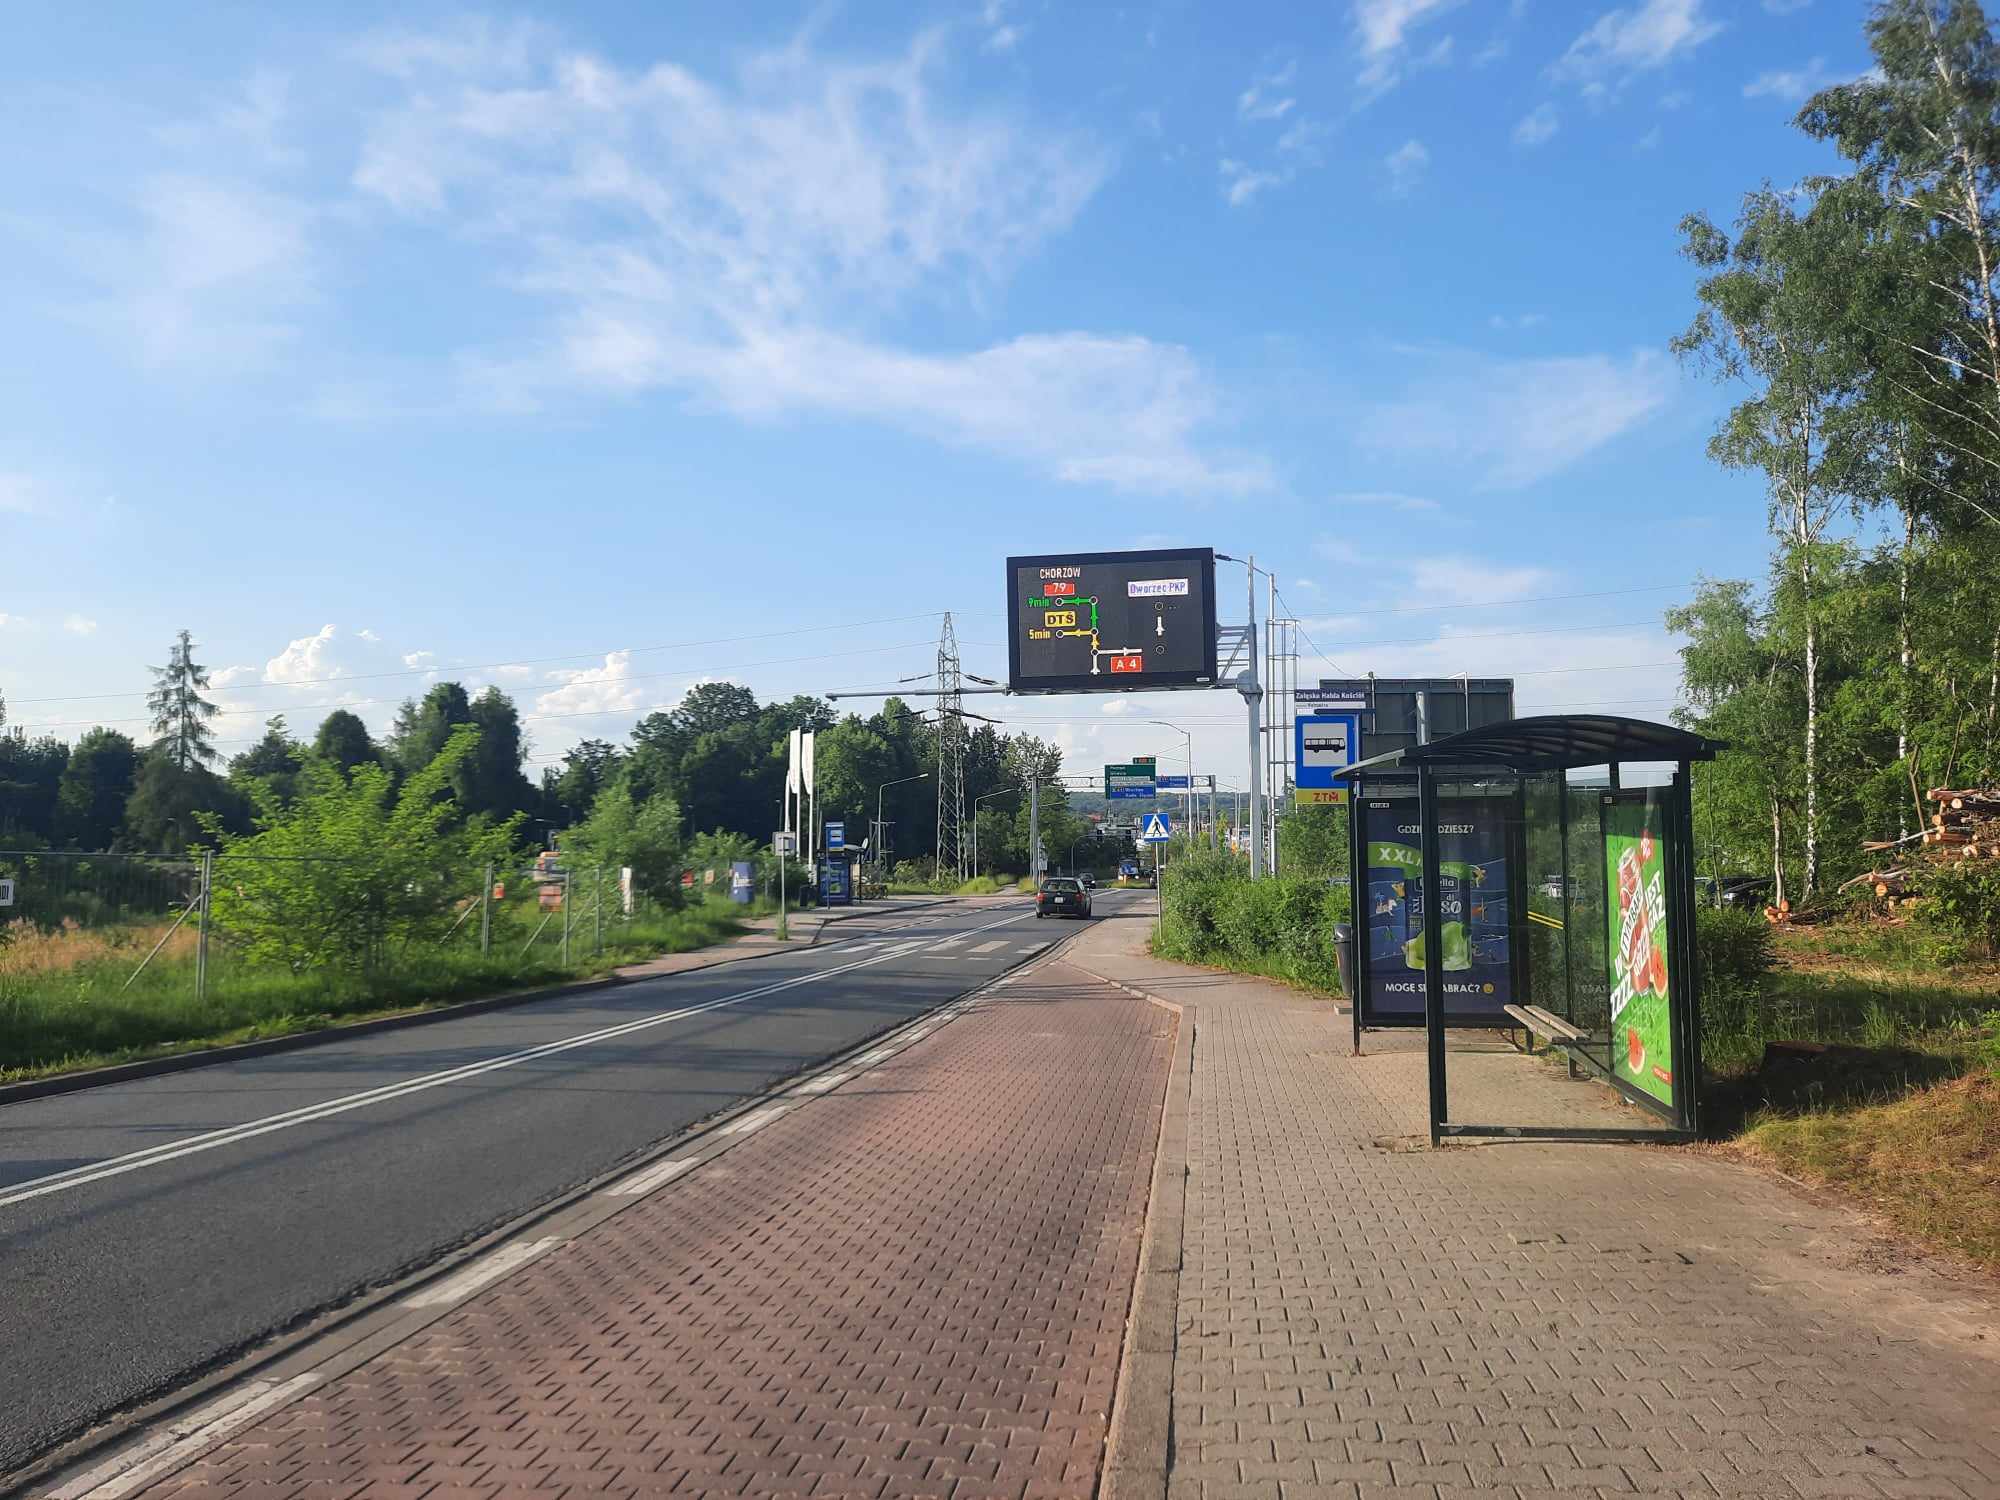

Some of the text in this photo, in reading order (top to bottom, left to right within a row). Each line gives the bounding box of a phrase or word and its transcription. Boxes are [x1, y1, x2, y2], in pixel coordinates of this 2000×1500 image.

[1052, 582, 1066, 593] 79
[1130, 582, 1185, 593] Dworzec PKP
[1029, 629, 1051, 640] 5min
[1312, 791, 1339, 802] ZTM
[1397, 825, 1474, 834] GDZI DZIESZ?
[1379, 847, 1414, 864] XXL
[1442, 983, 1480, 993] ABRAĆ?
